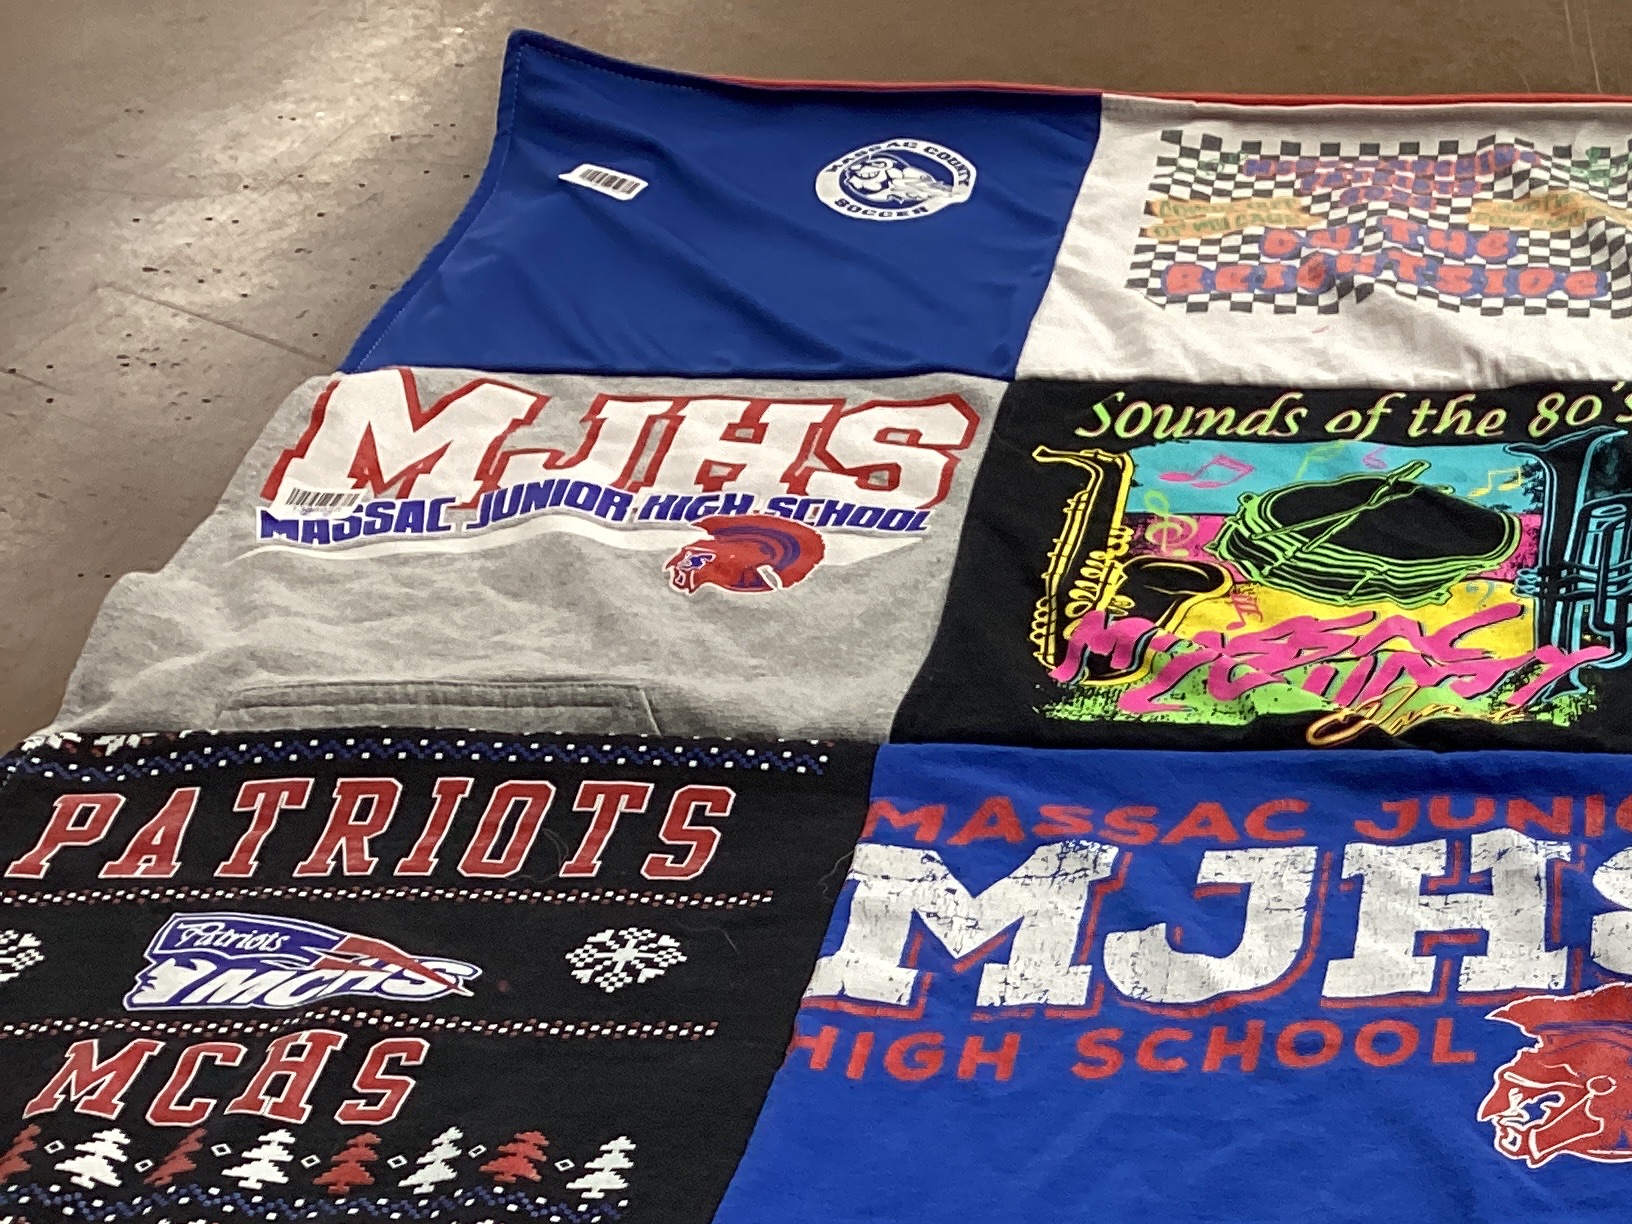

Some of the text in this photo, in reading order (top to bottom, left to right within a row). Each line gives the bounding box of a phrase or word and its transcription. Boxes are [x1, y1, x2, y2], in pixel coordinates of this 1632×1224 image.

[923, 146, 971, 187] COUNTY
[834, 198, 929, 218] SOCCER
[1377, 215, 1518, 261] THE
[262, 367, 981, 510] MJHS
[1076, 391, 1308, 439] Sounds
[1324, 392, 1391, 441] of
[1408, 397, 1506, 438] the
[260, 478, 930, 545] MASSAC JUNIOR HIGH SCHOOL
[4, 777, 736, 880] PATRIOTS
[866, 796, 1312, 844] MASSAC
[178, 921, 291, 953] Patriots
[180, 957, 481, 1005] MCHS
[793, 1018, 1477, 1082] HIGH SCHOOL
[22, 1029, 430, 1126] MCHS
